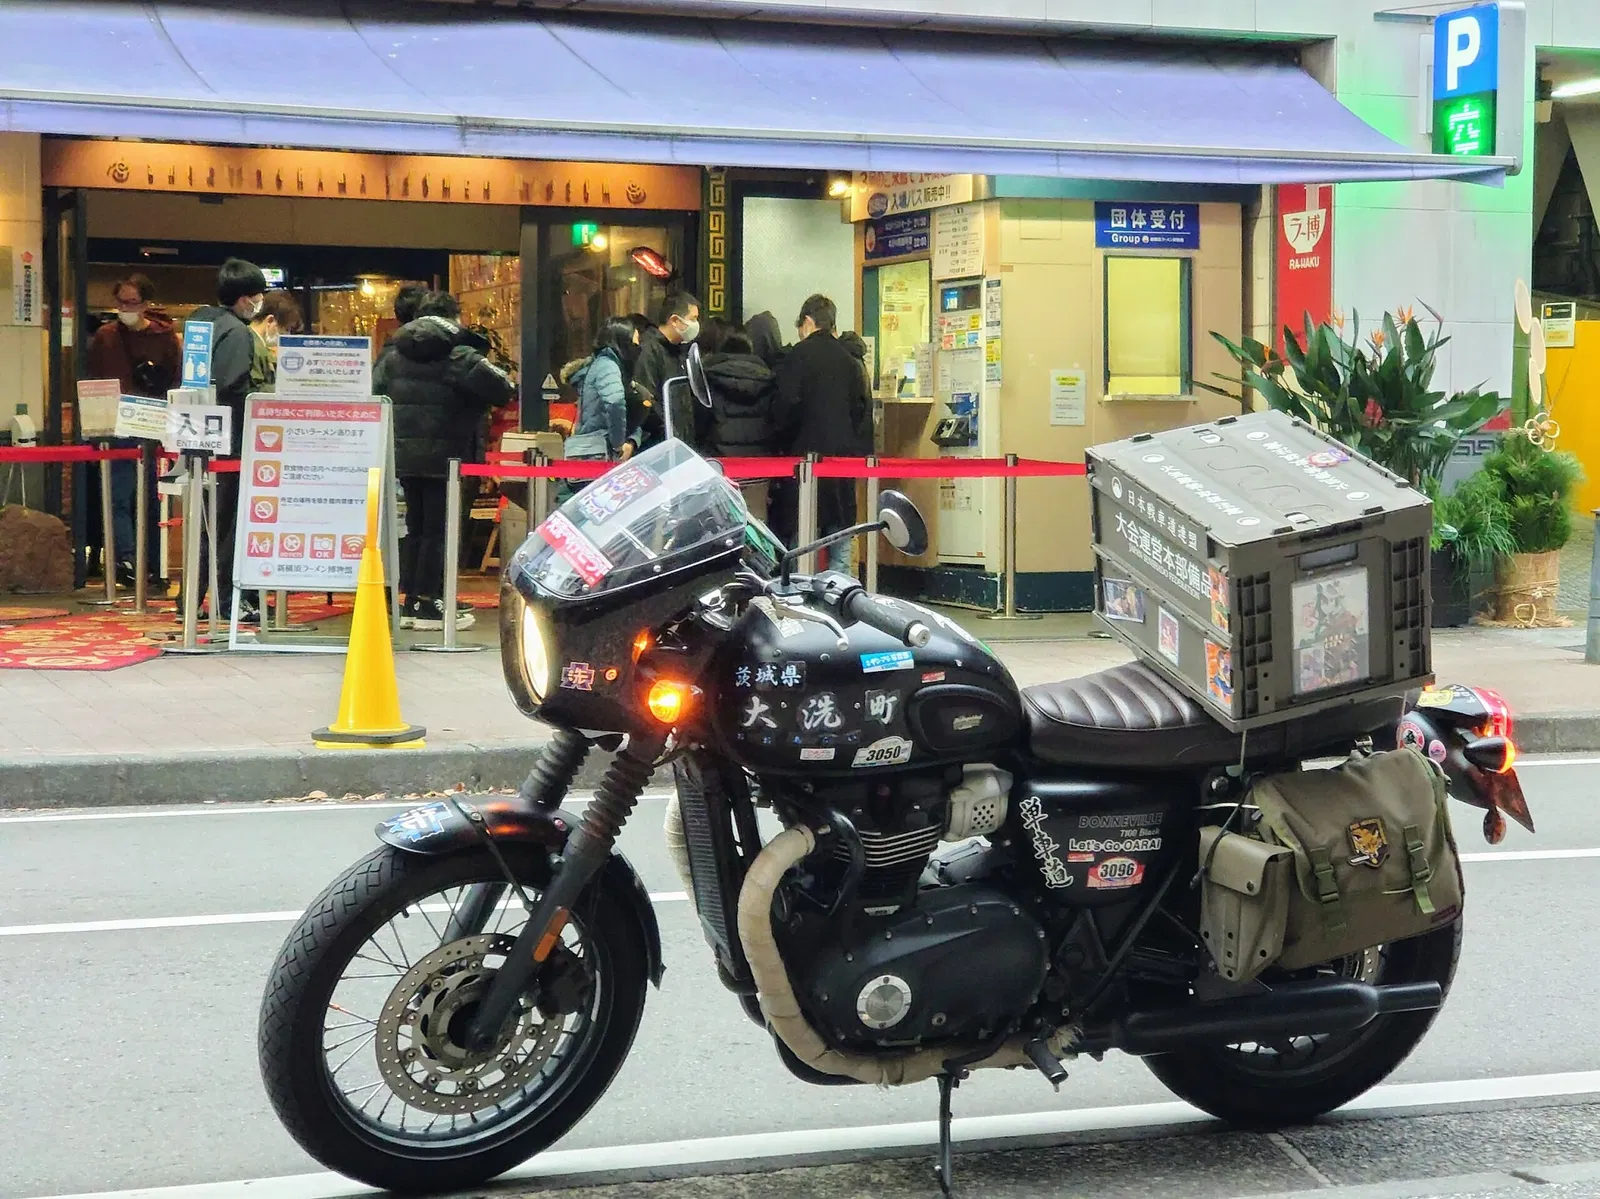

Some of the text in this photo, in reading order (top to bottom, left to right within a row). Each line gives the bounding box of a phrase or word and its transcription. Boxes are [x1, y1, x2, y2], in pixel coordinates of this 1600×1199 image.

[1447, 16, 1481, 91] P
[1110, 208, 1186, 230] 団体受付
[1111, 233, 1141, 245] Group
[176, 412, 223, 436] 入口
[176, 439, 222, 449] ENTRANCE
[315, 550, 330, 558] OK
[1114, 511, 1213, 600] 大会運営本部備品
[735, 664, 802, 687] 茨城県
[865, 745, 902, 762] 3050
[1078, 812, 1164, 829] BONNEVILLE
[1119, 828, 1161, 838] T100 Black
[1103, 839, 1121, 852] Go
[1122, 837, 1162, 852] OARAI
[1100, 862, 1136, 878] 3096
